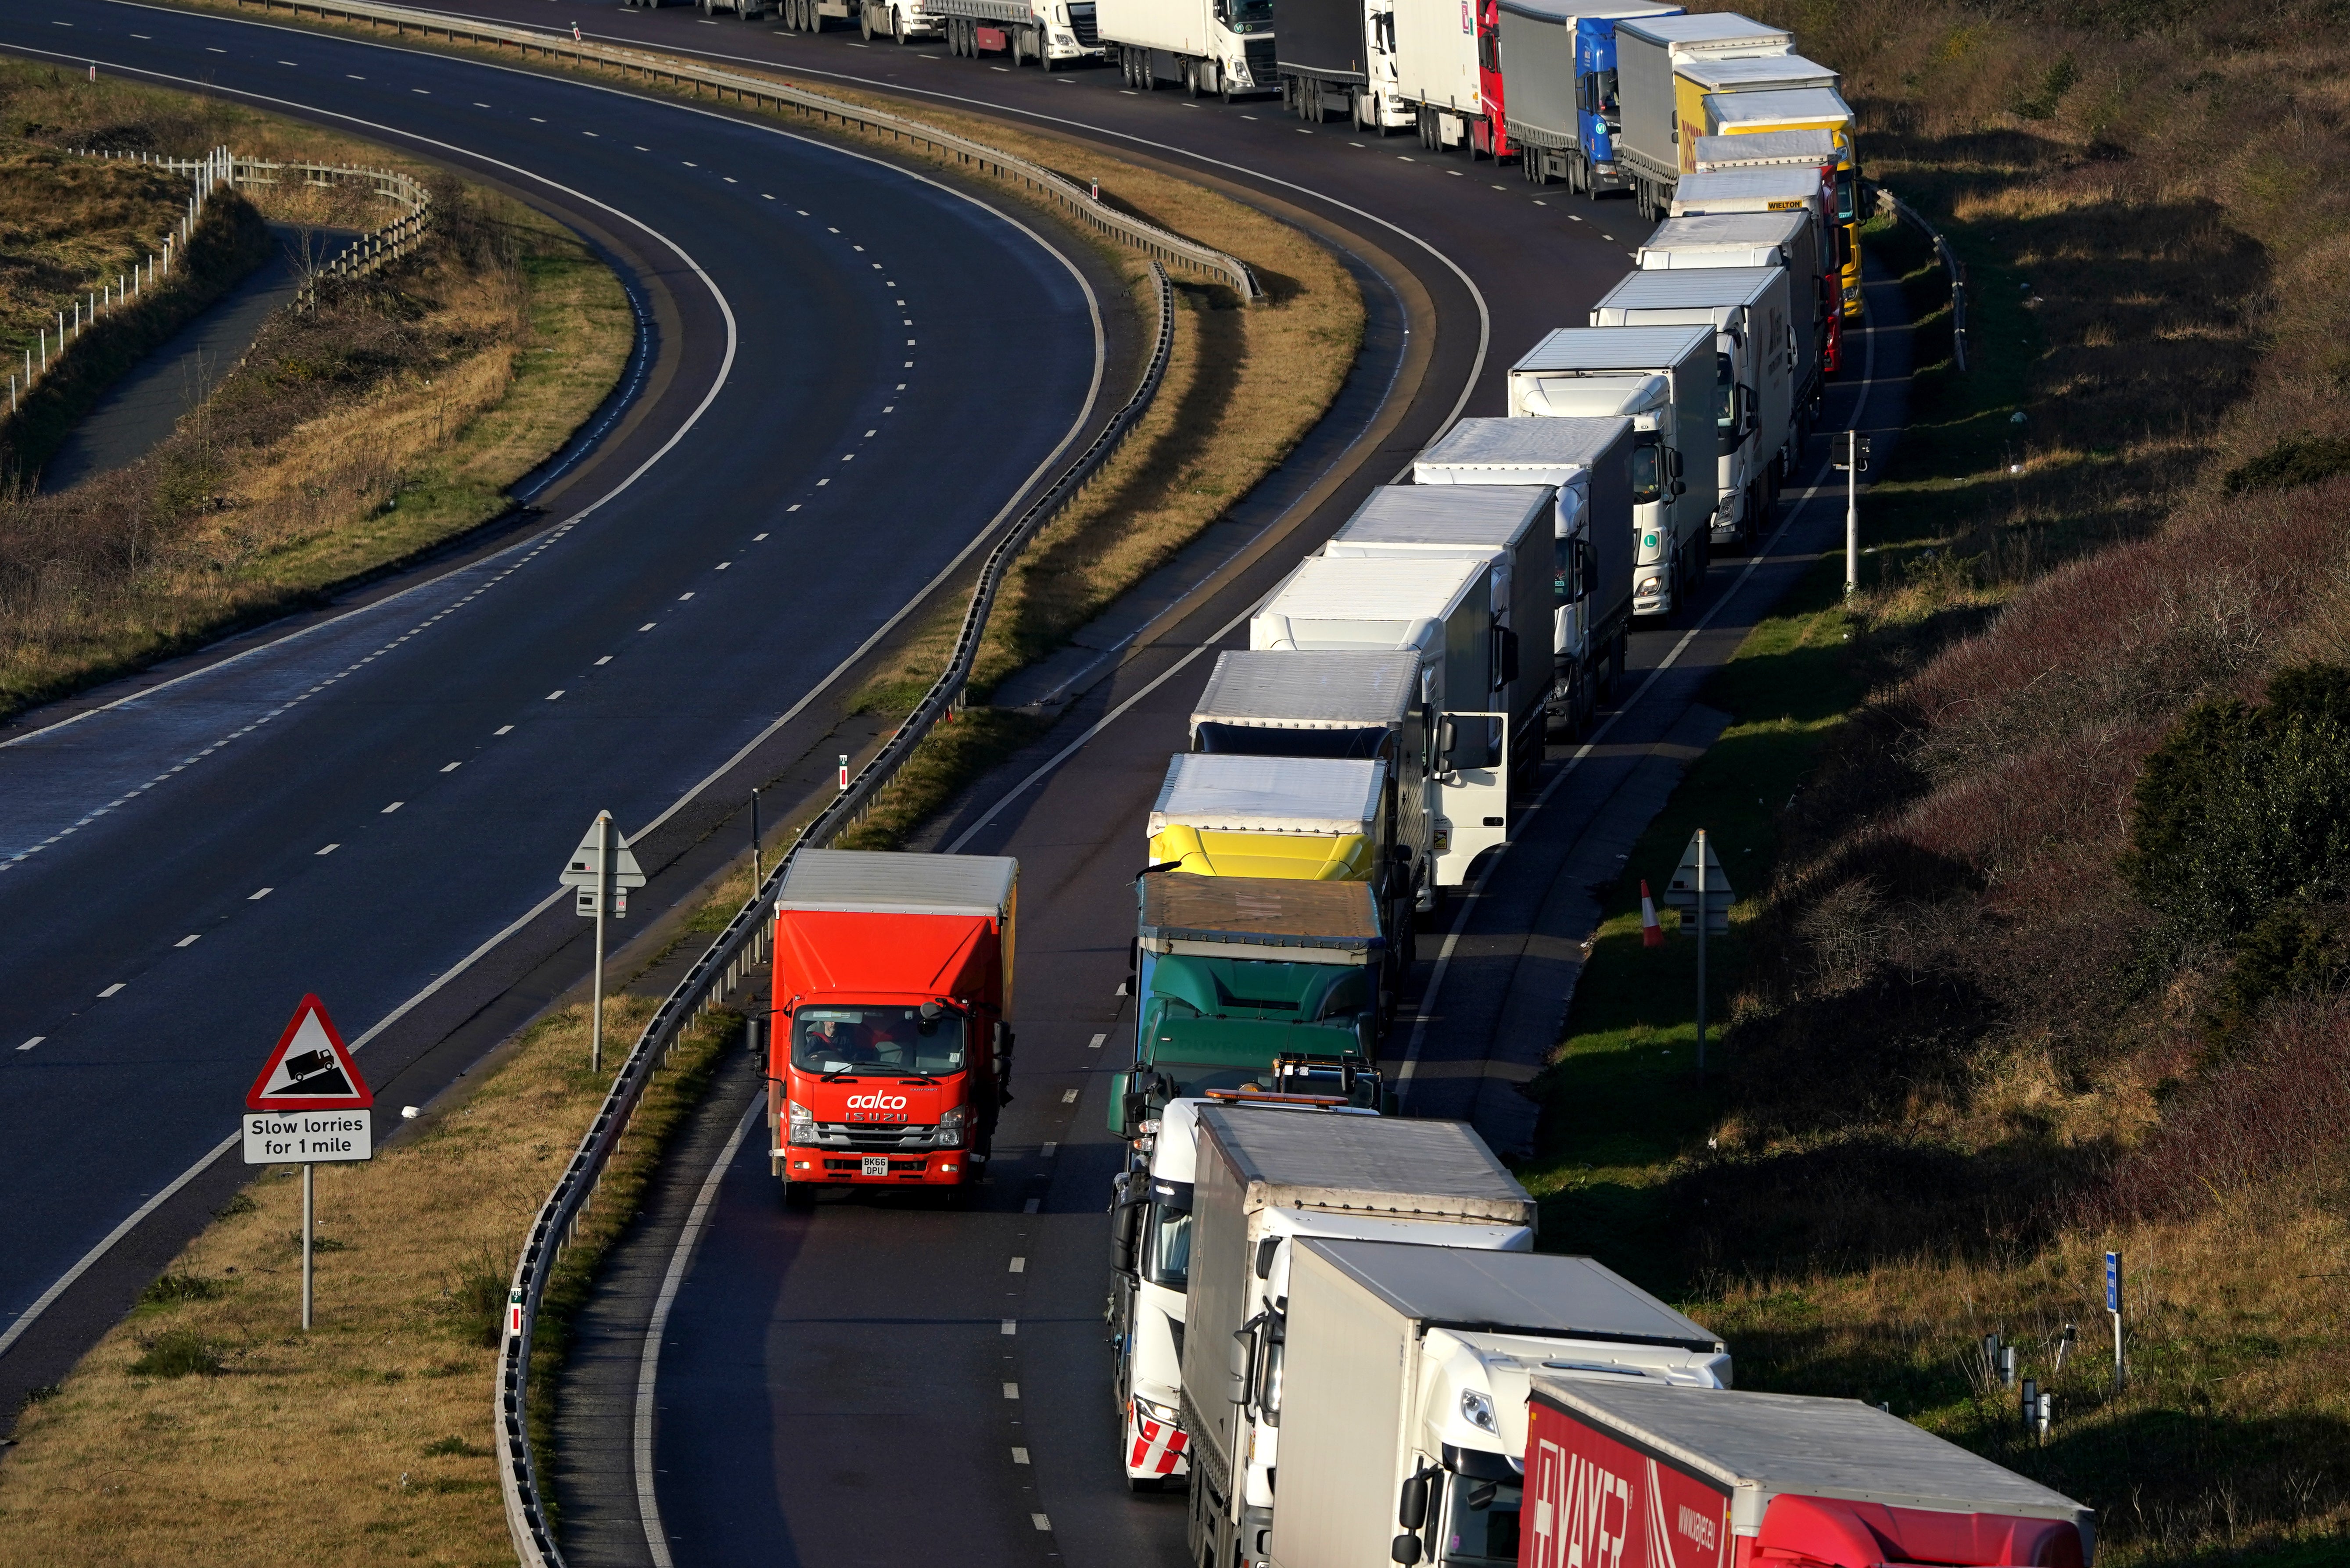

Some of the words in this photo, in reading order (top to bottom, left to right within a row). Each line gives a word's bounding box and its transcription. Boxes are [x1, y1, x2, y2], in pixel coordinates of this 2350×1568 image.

[1647, 537, 1653, 545] L
[847, 1090, 907, 1110] aalco
[846, 1112, 908, 1122] ISUZU
[251, 1120, 298, 1135] Slow
[305, 1117, 363, 1132] lorries
[265, 1140, 291, 1154] for
[299, 1139, 305, 1153] 1
[312, 1138, 352, 1153] mile
[1678, 1504, 1716, 1552] www.vayer.eu
